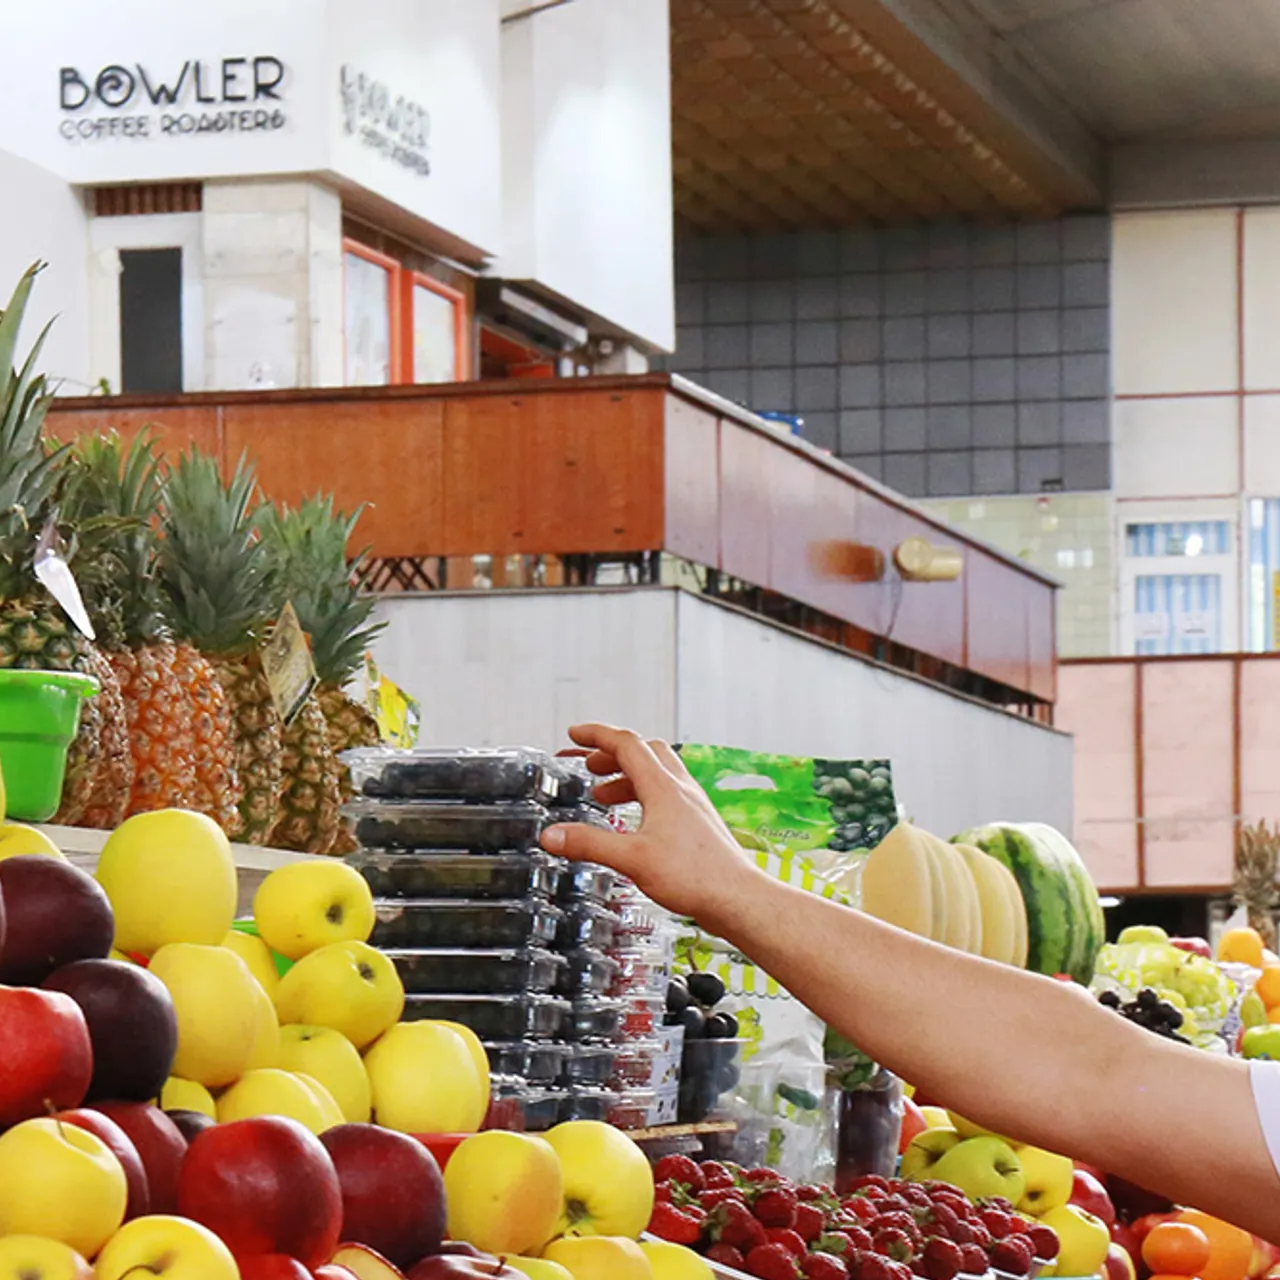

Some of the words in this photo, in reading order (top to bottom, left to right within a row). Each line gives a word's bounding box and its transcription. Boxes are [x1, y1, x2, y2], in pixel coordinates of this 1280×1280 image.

[59, 56, 285, 110] BOWLER
[58, 115, 150, 140] COFFEE
[160, 109, 286, 133] ROASTERS
